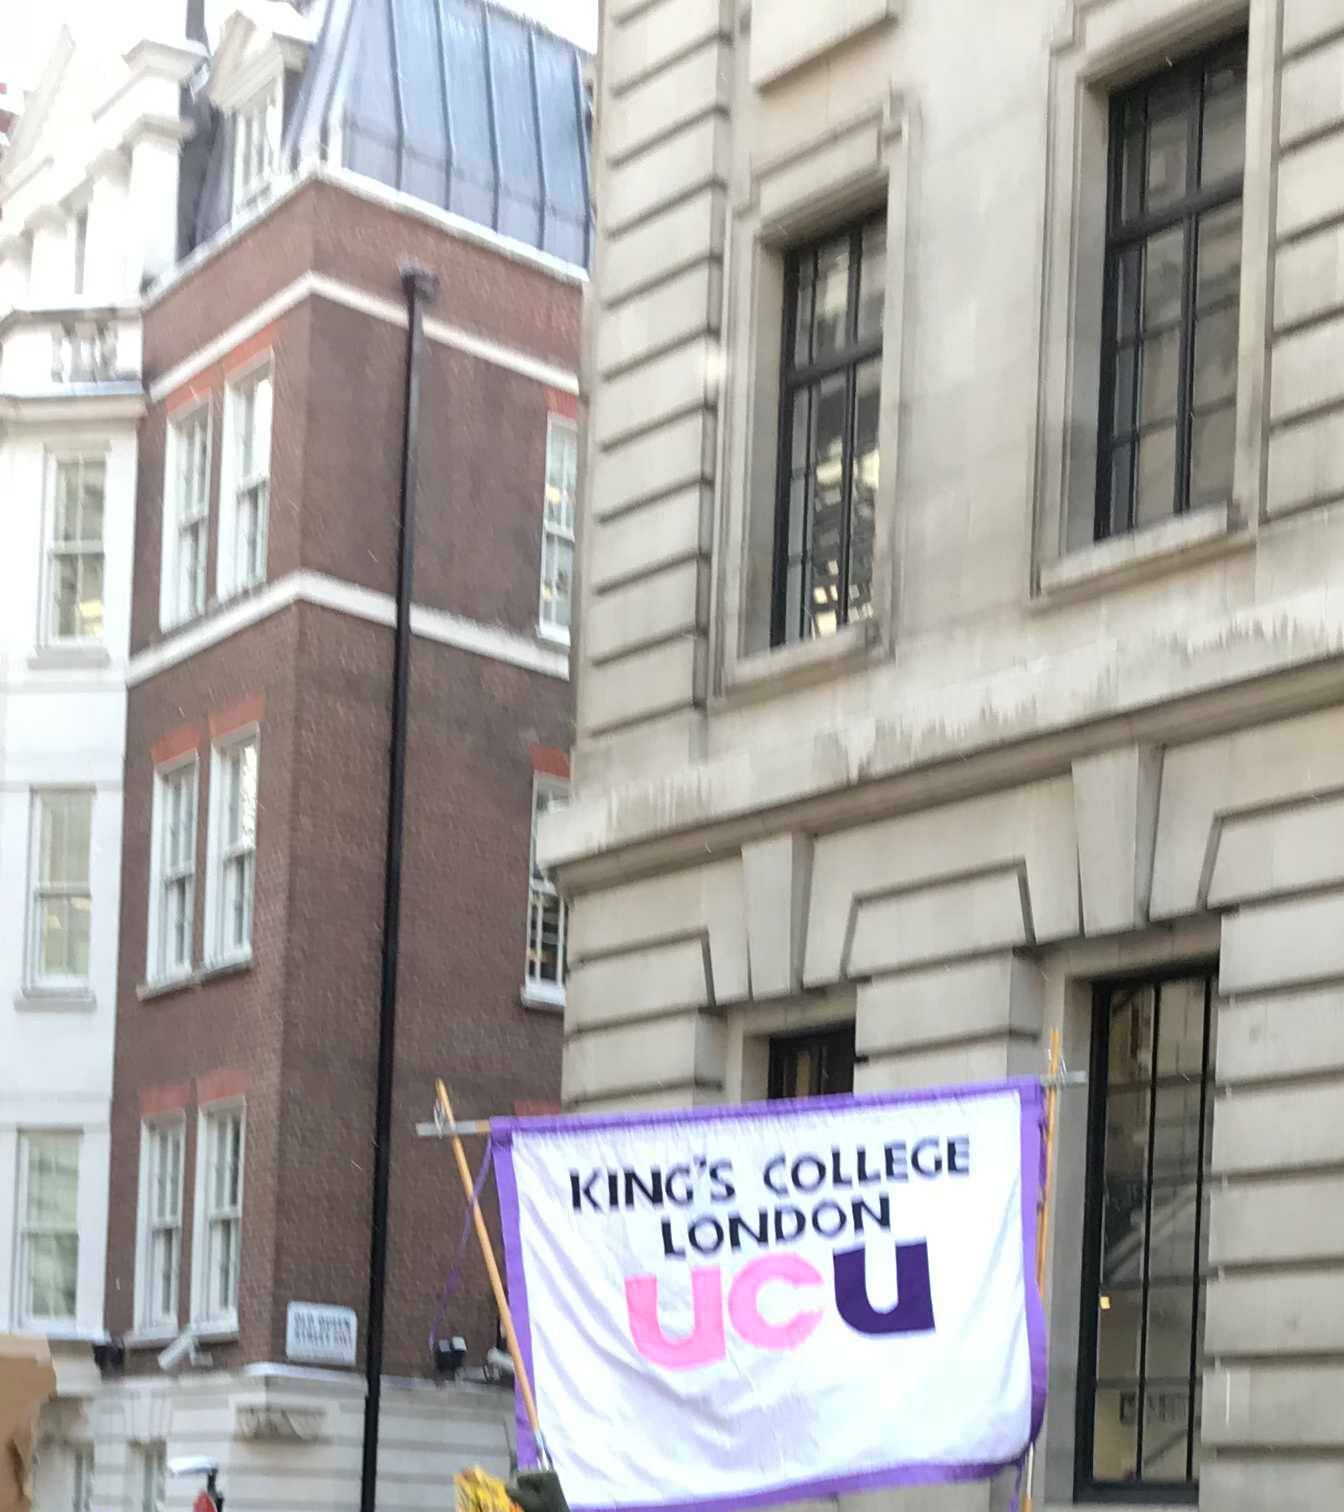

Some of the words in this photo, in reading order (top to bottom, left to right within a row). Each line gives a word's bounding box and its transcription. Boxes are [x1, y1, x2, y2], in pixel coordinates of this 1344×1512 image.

[570, 1154, 736, 1213] KING'S
[762, 1136, 970, 1197] COLLEGE
[660, 1191, 891, 1260] LONDON
